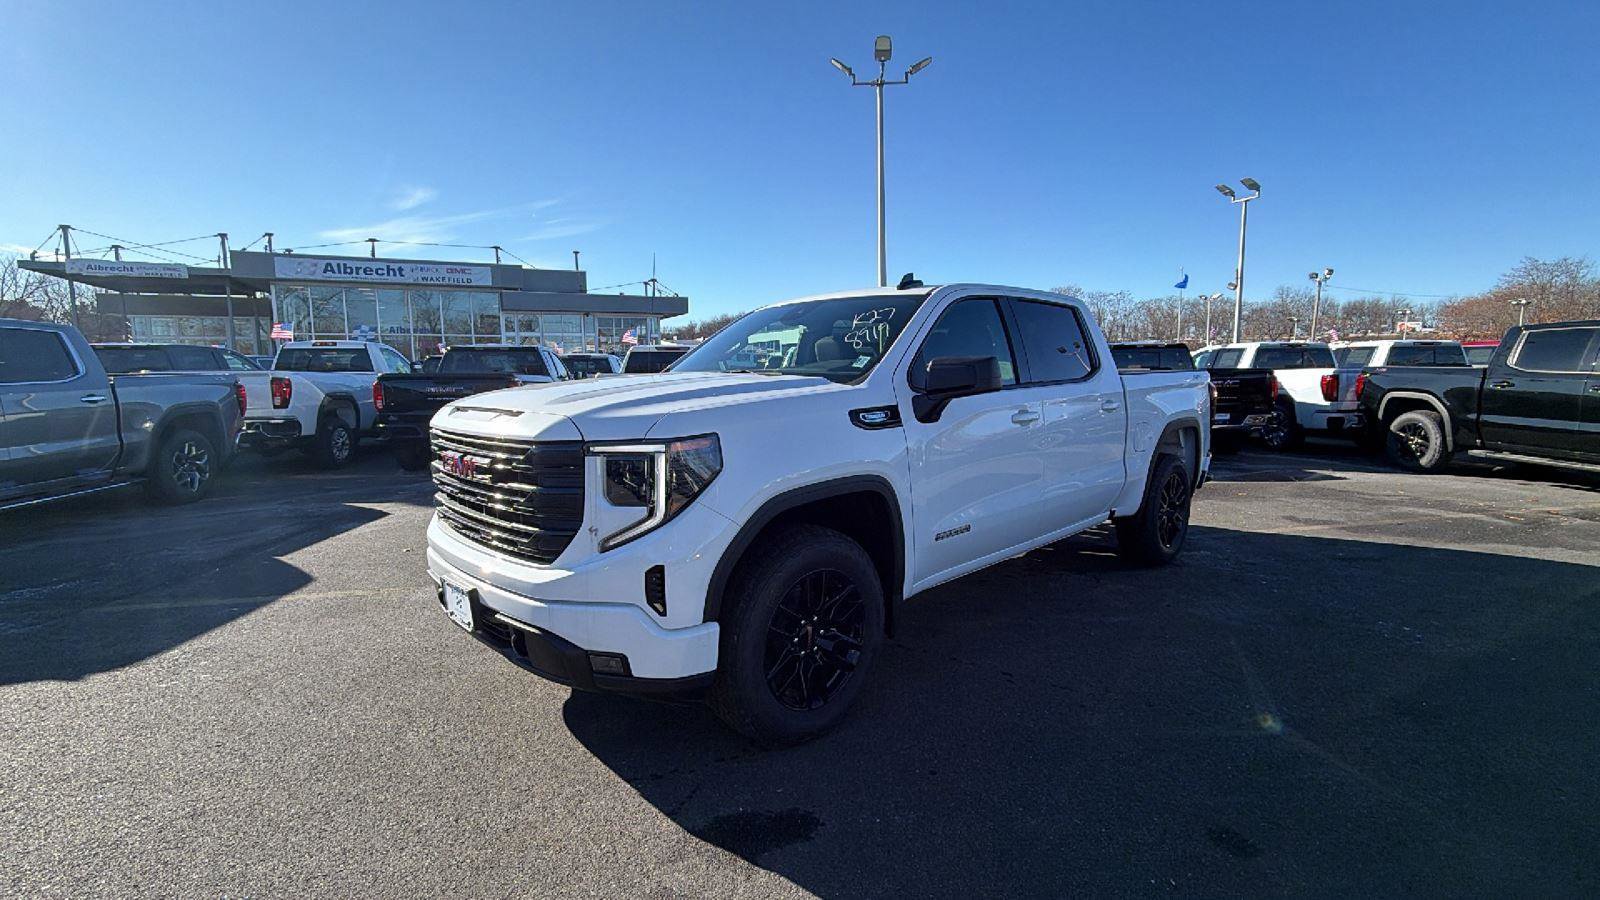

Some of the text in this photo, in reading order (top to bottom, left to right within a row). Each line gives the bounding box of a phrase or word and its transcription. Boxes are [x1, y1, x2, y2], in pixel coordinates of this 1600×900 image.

[86, 263, 135, 273] Albrecht
[322, 262, 405, 277] Albrecht
[446, 267, 473, 275] GMC
[421, 276, 473, 284] WAKEFIELD
